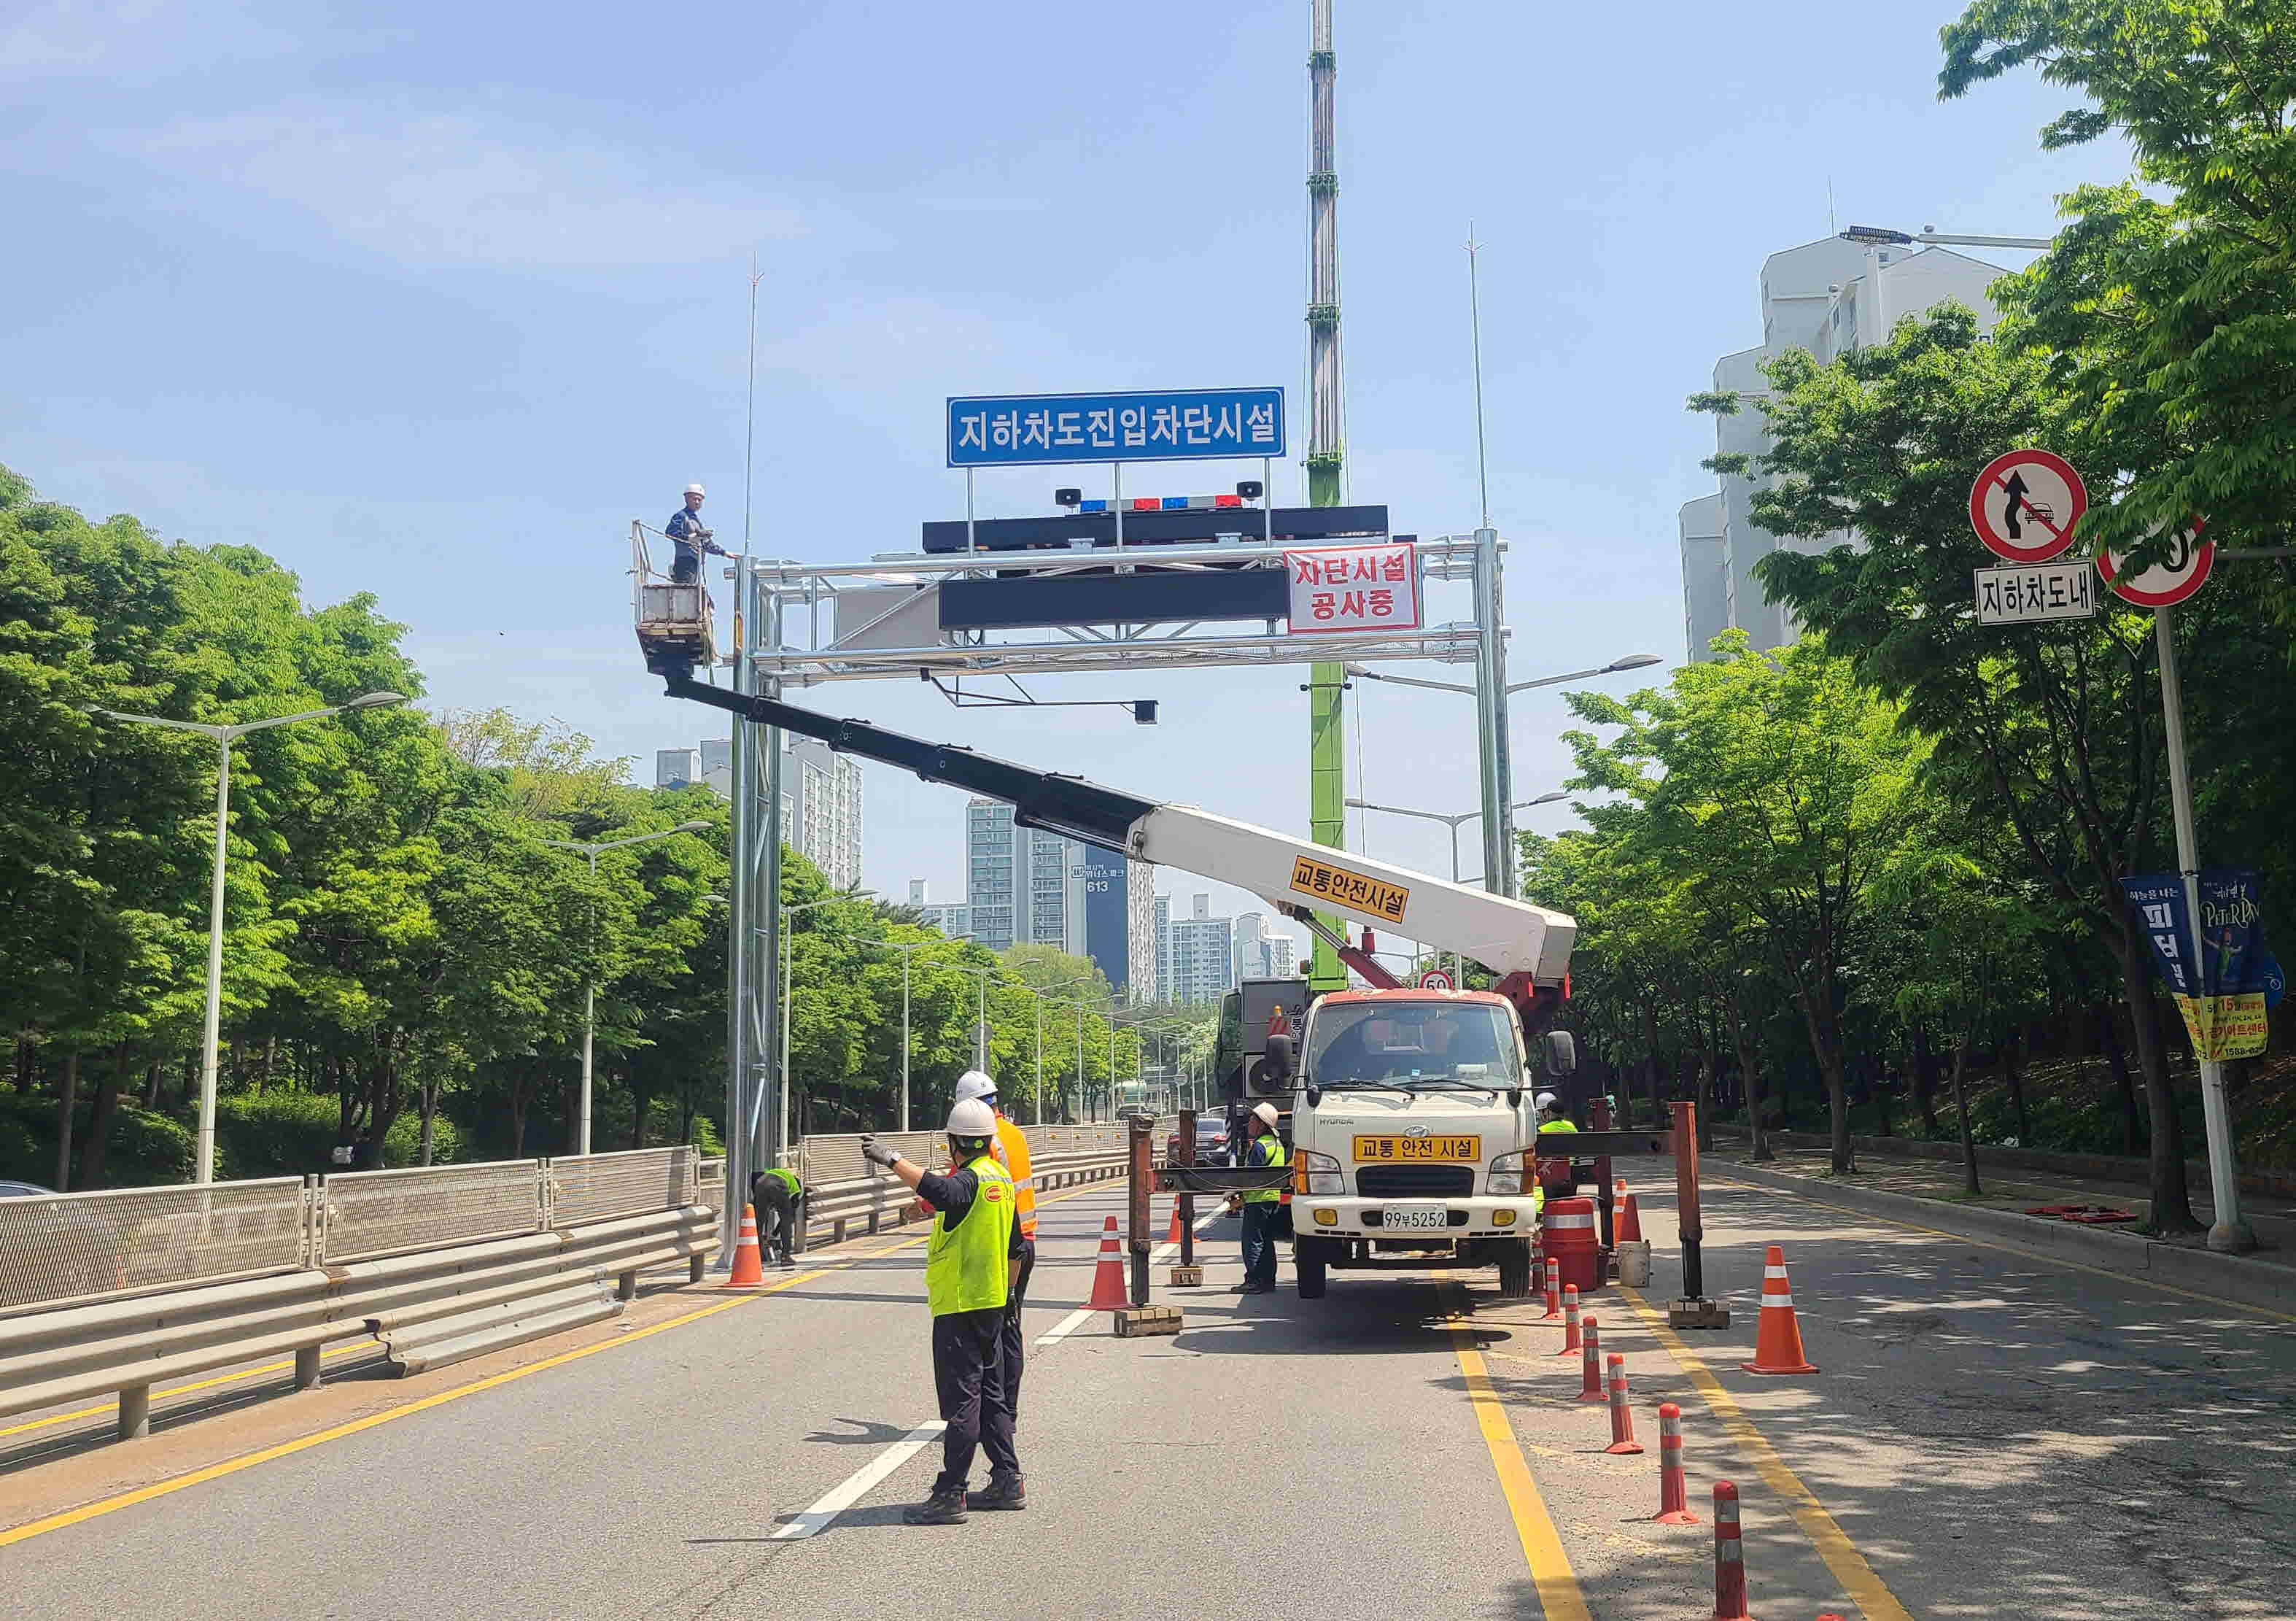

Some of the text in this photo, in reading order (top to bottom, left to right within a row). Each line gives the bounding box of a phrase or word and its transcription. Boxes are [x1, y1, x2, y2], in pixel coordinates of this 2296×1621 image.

[958, 403, 1276, 451] 지하차도진입차단시설
[1295, 554, 1406, 586] 차단시설
[1311, 587, 1395, 620] 공사중
[1982, 570, 2088, 616] 지하차도내
[1087, 881, 1108, 892] 613
[1295, 862, 1405, 916] 교통안전시설
[1427, 979, 1446, 990] 50
[1361, 1139, 1471, 1158] 교통 안전 시설
[1384, 1211, 1446, 1228] 99부5252
